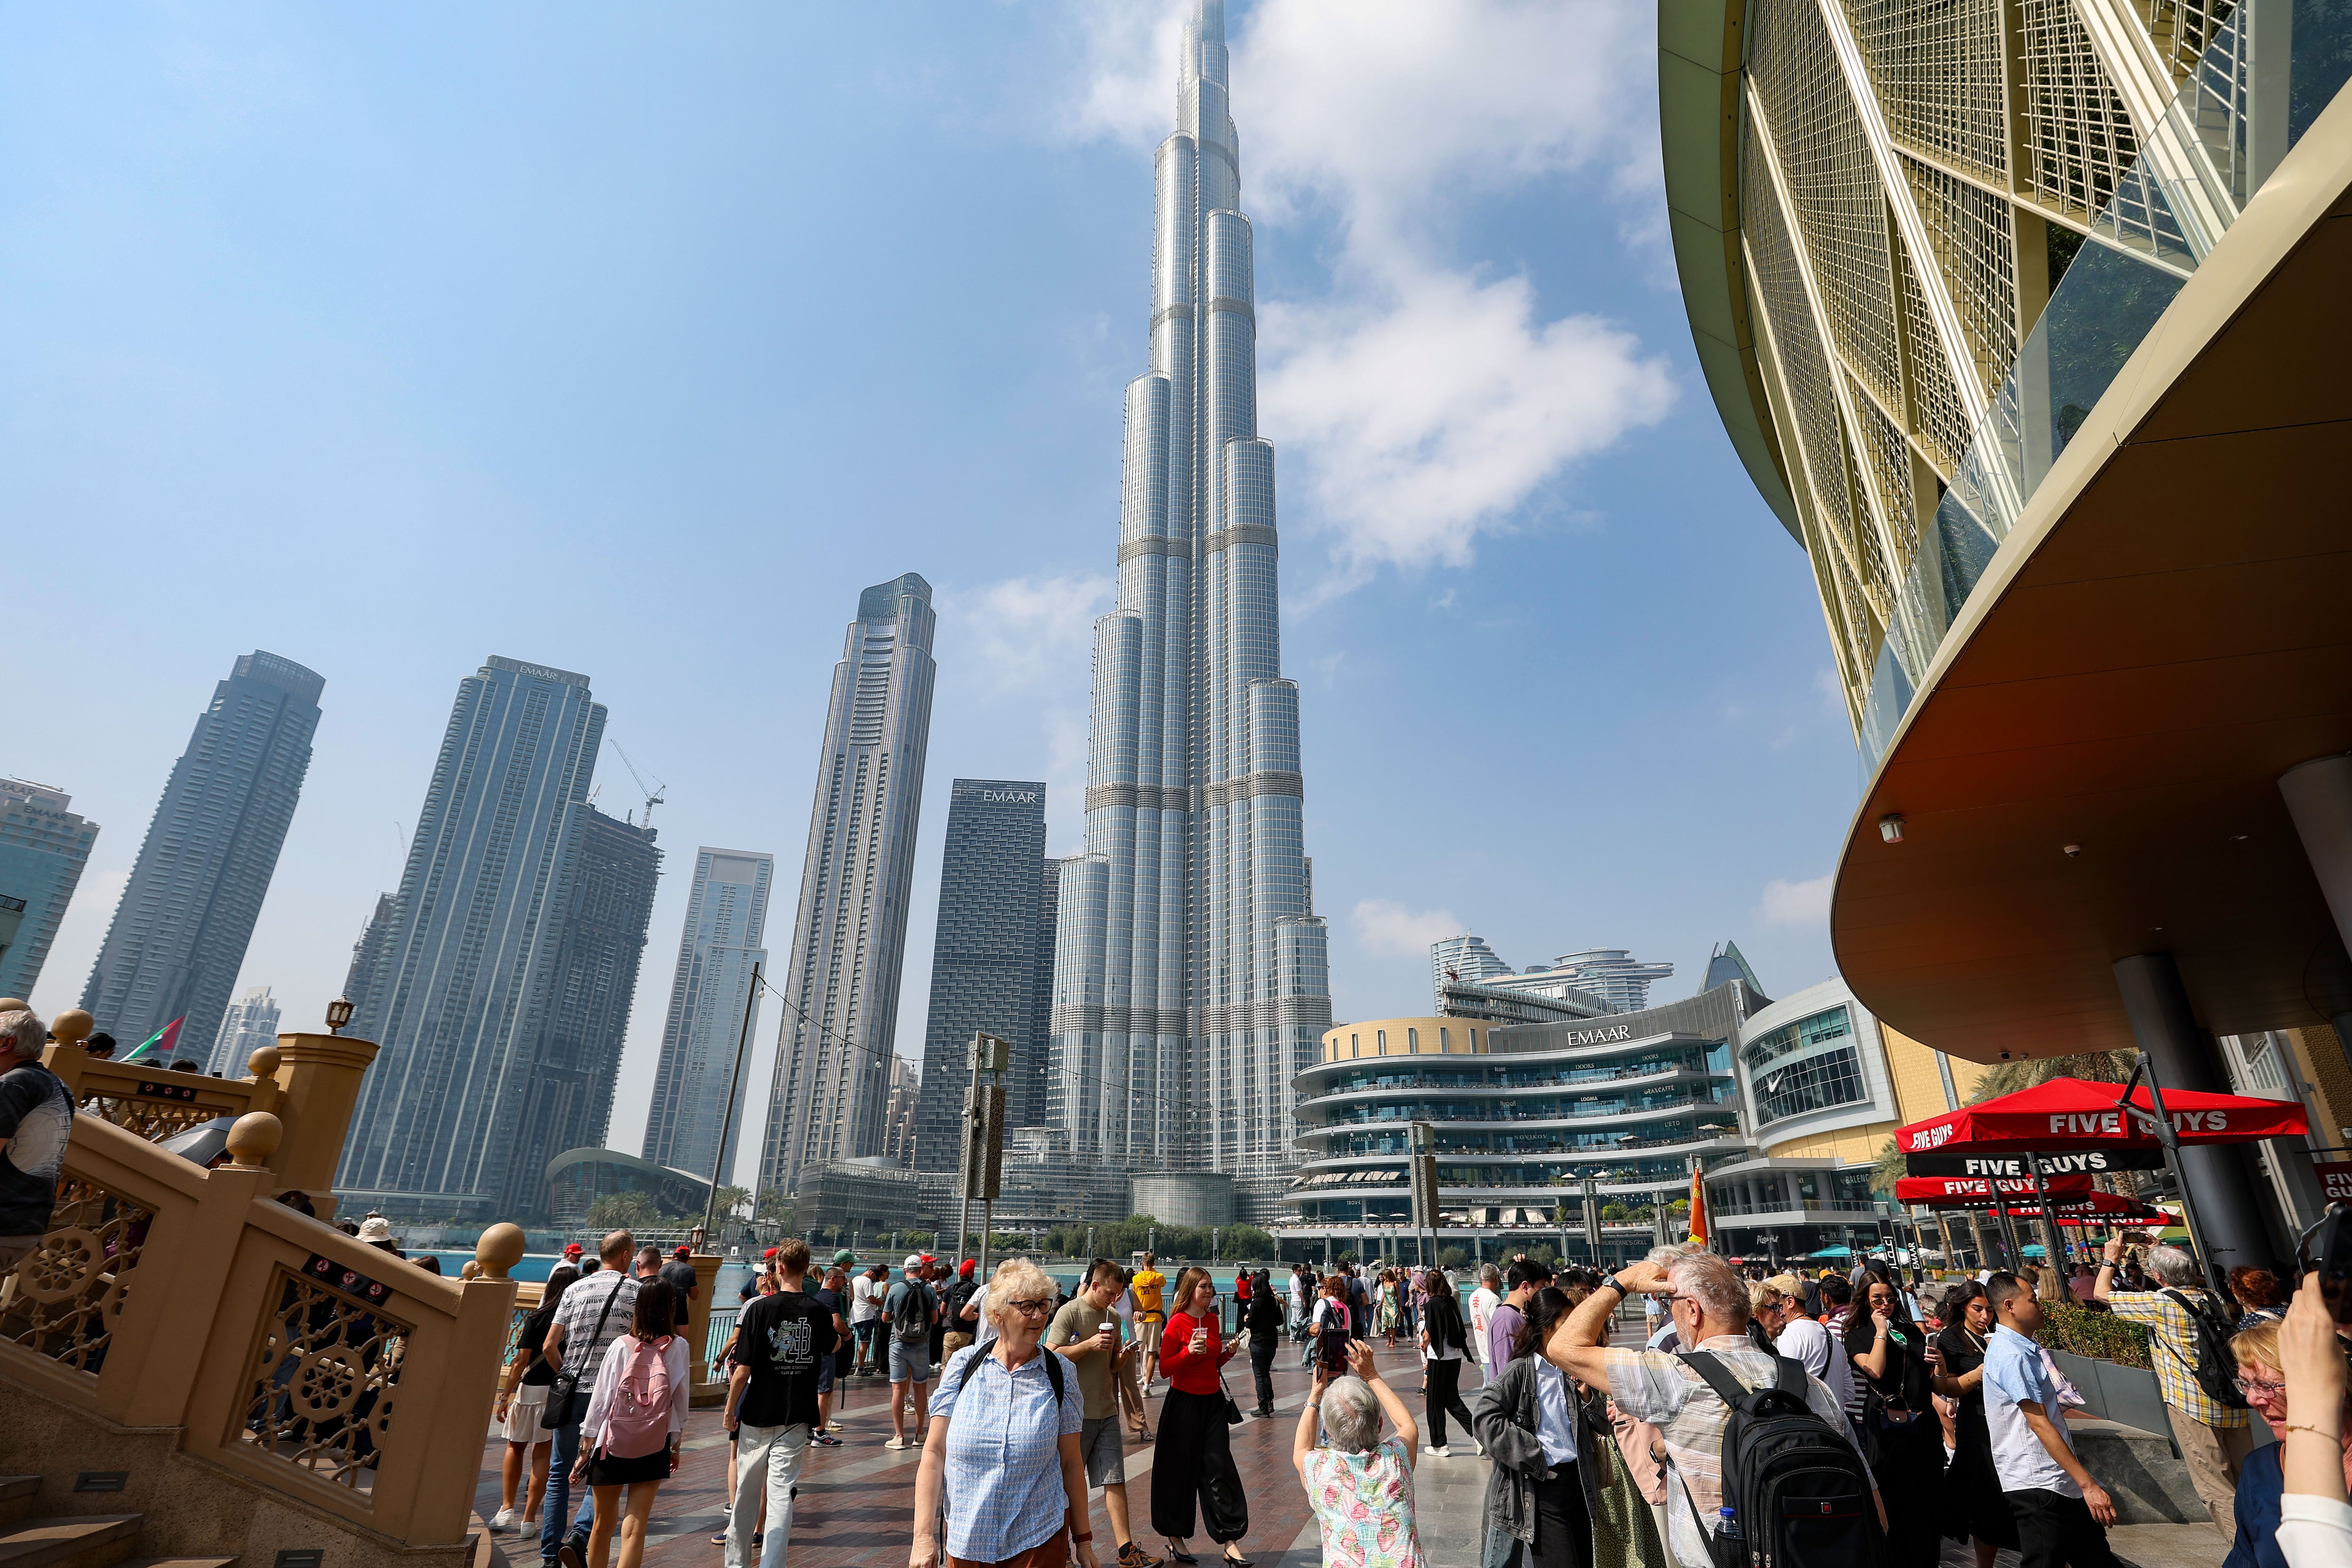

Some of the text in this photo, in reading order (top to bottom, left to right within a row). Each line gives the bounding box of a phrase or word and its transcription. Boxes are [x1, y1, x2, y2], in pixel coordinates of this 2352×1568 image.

[520, 665, 556, 680] EMAAR
[984, 791, 1036, 803] EMAAR
[24, 805, 67, 821] EMAAR
[1567, 1025, 1631, 1045] EMAAR
[2050, 1113, 2121, 1133] FIVE
[1910, 1123, 1953, 1149] FIVE GUYS
[1966, 1153, 2107, 1175] FIVE GUYS
[1944, 1178, 2050, 1194] FIVE GUYS
[1757, 1234, 1779, 1245] Pizza Hut
[1908, 1242, 1920, 1269] EMAAR
